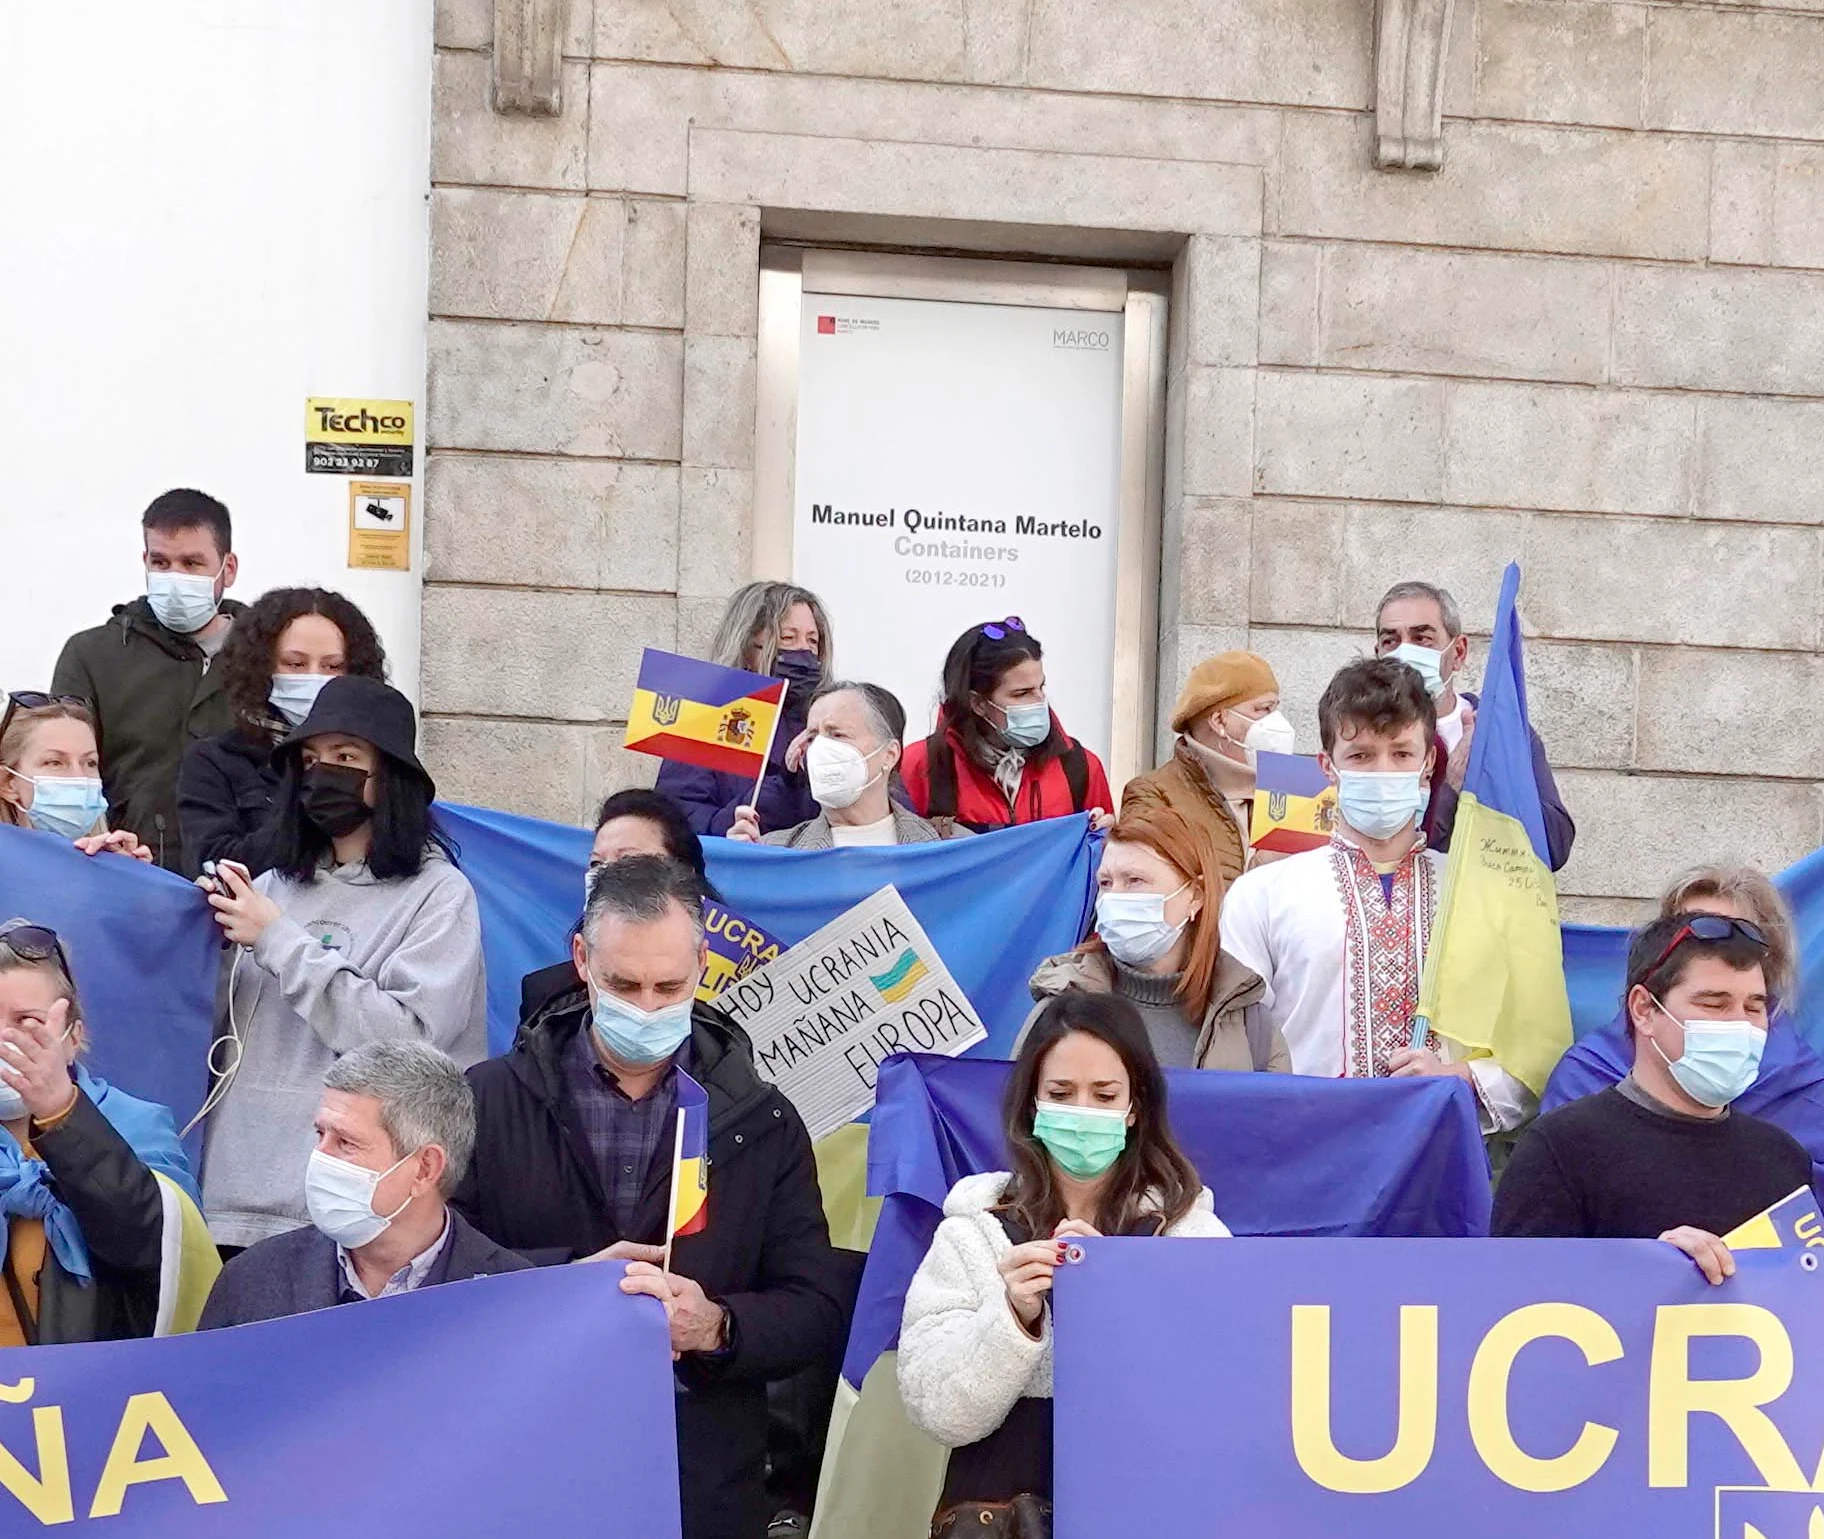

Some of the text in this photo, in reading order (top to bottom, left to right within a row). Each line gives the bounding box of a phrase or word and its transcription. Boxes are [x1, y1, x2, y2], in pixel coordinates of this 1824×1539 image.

[1053, 329, 1110, 347] MARCO
[314, 407, 406, 433] Techco
[811, 504, 1102, 540] Manuel Quintana Martelo
[894, 535, 1019, 562] Containers
[905, 568, 1006, 588] (2012-2021)
[717, 917, 910, 1020] HOY UCRANIA
[758, 990, 876, 1077] MAÑANA
[844, 989, 976, 1089] EUROPA
